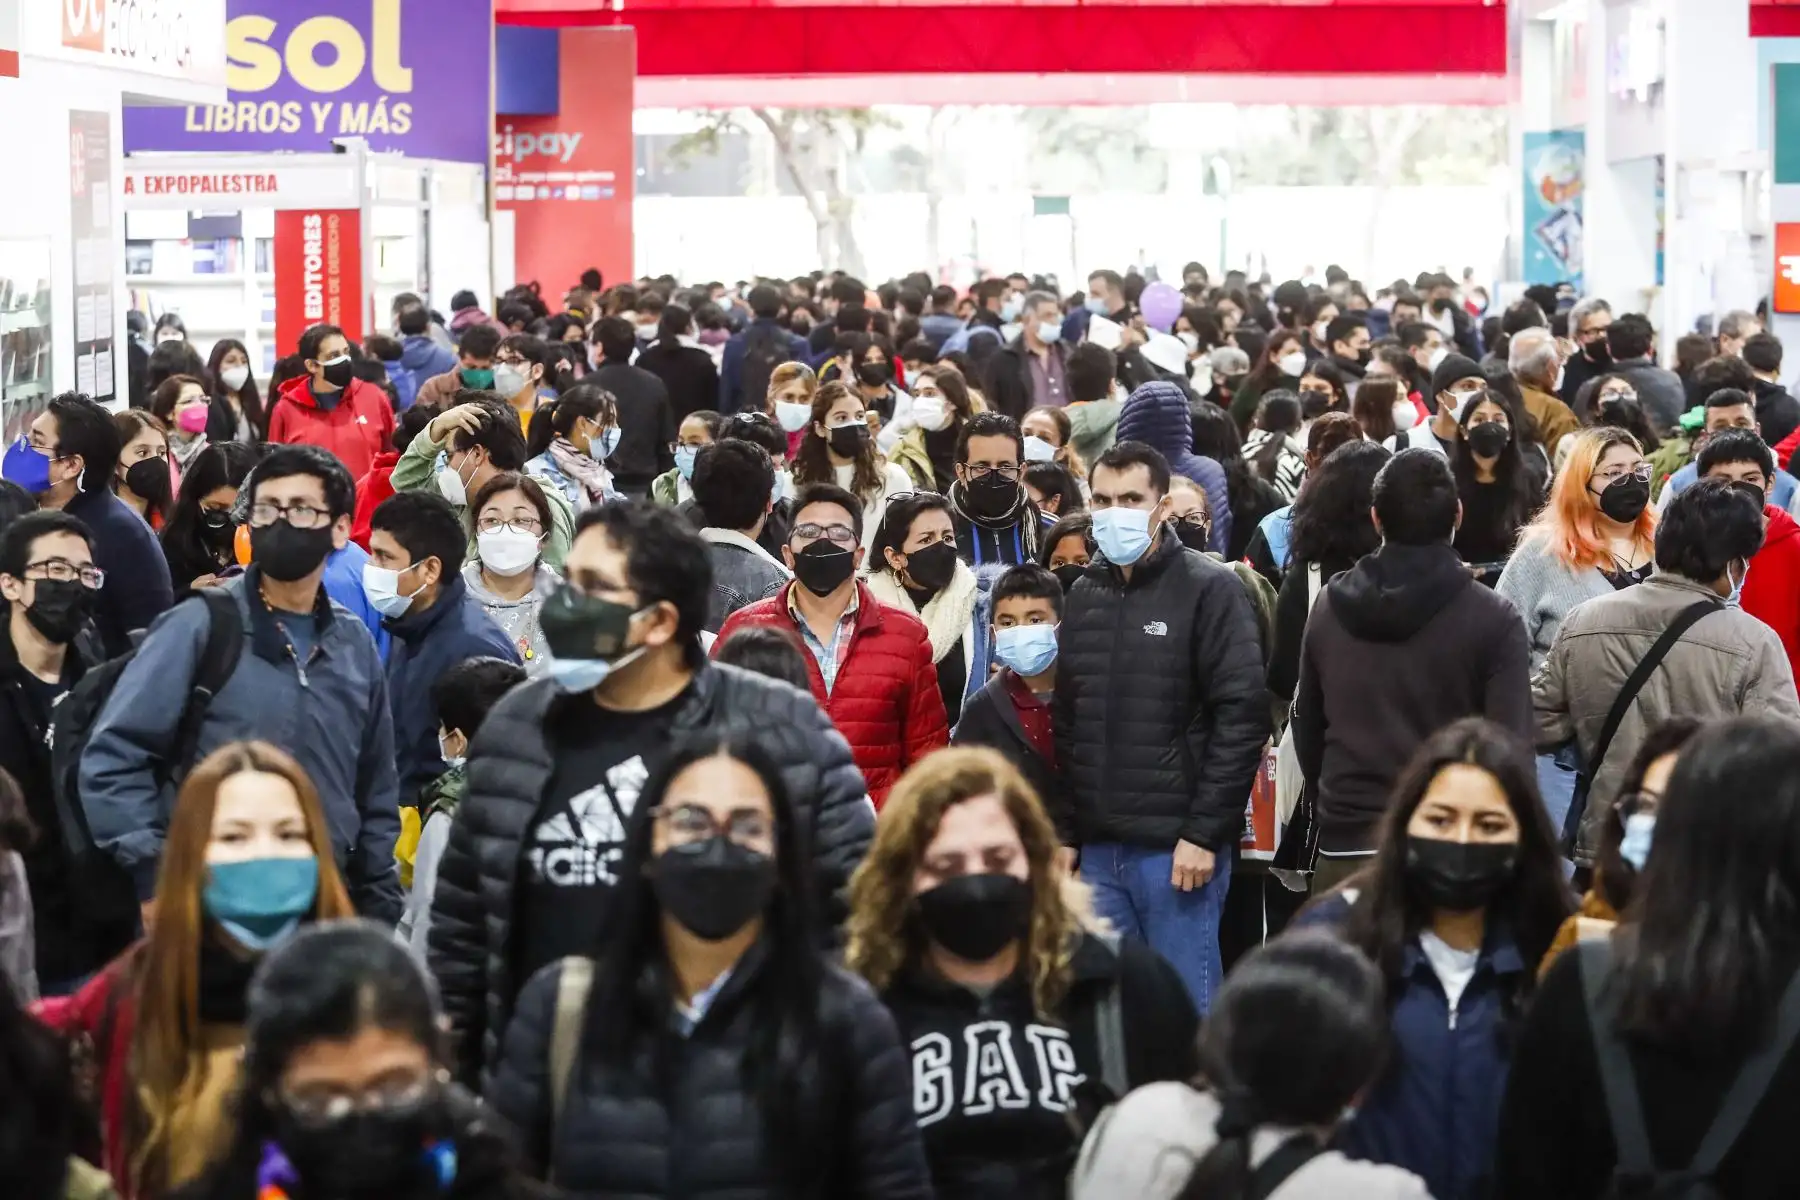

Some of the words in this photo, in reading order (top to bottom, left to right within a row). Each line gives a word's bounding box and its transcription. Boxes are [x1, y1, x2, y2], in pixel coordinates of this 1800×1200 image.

[184, 101, 303, 133] LIBROS
[310, 102, 333, 134] Y
[338, 95, 413, 134] MÁS
[124, 176, 134, 194] A
[144, 174, 278, 194] EXPOPALESTRA
[304, 214, 323, 319] EDITORES
[910, 1020, 1087, 1128] GAP
